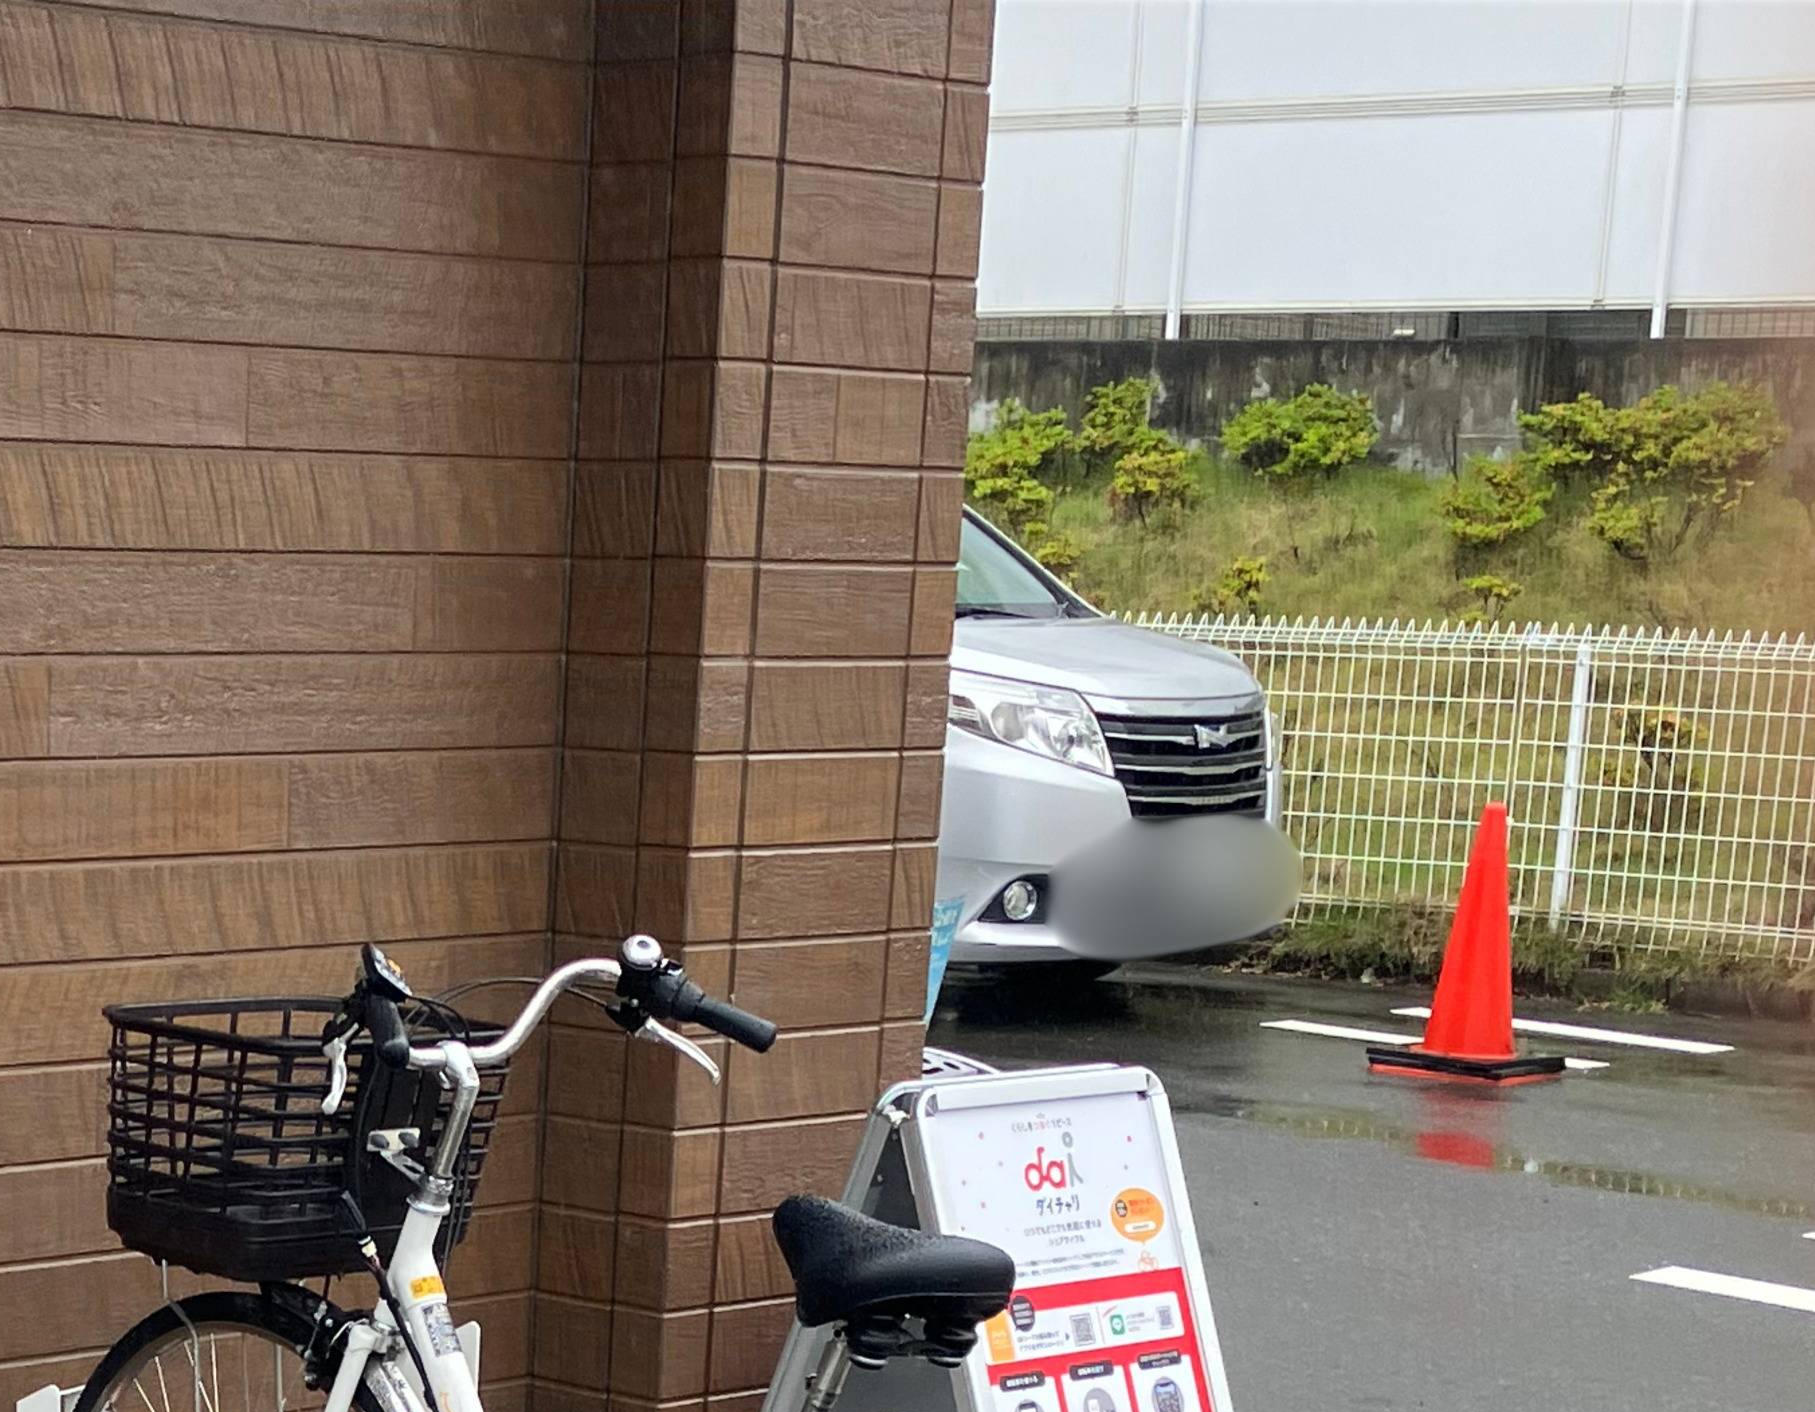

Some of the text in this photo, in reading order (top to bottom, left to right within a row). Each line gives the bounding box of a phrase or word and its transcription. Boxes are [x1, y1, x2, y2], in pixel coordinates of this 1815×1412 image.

[1035, 1194, 1080, 1216] ダイチャリ
